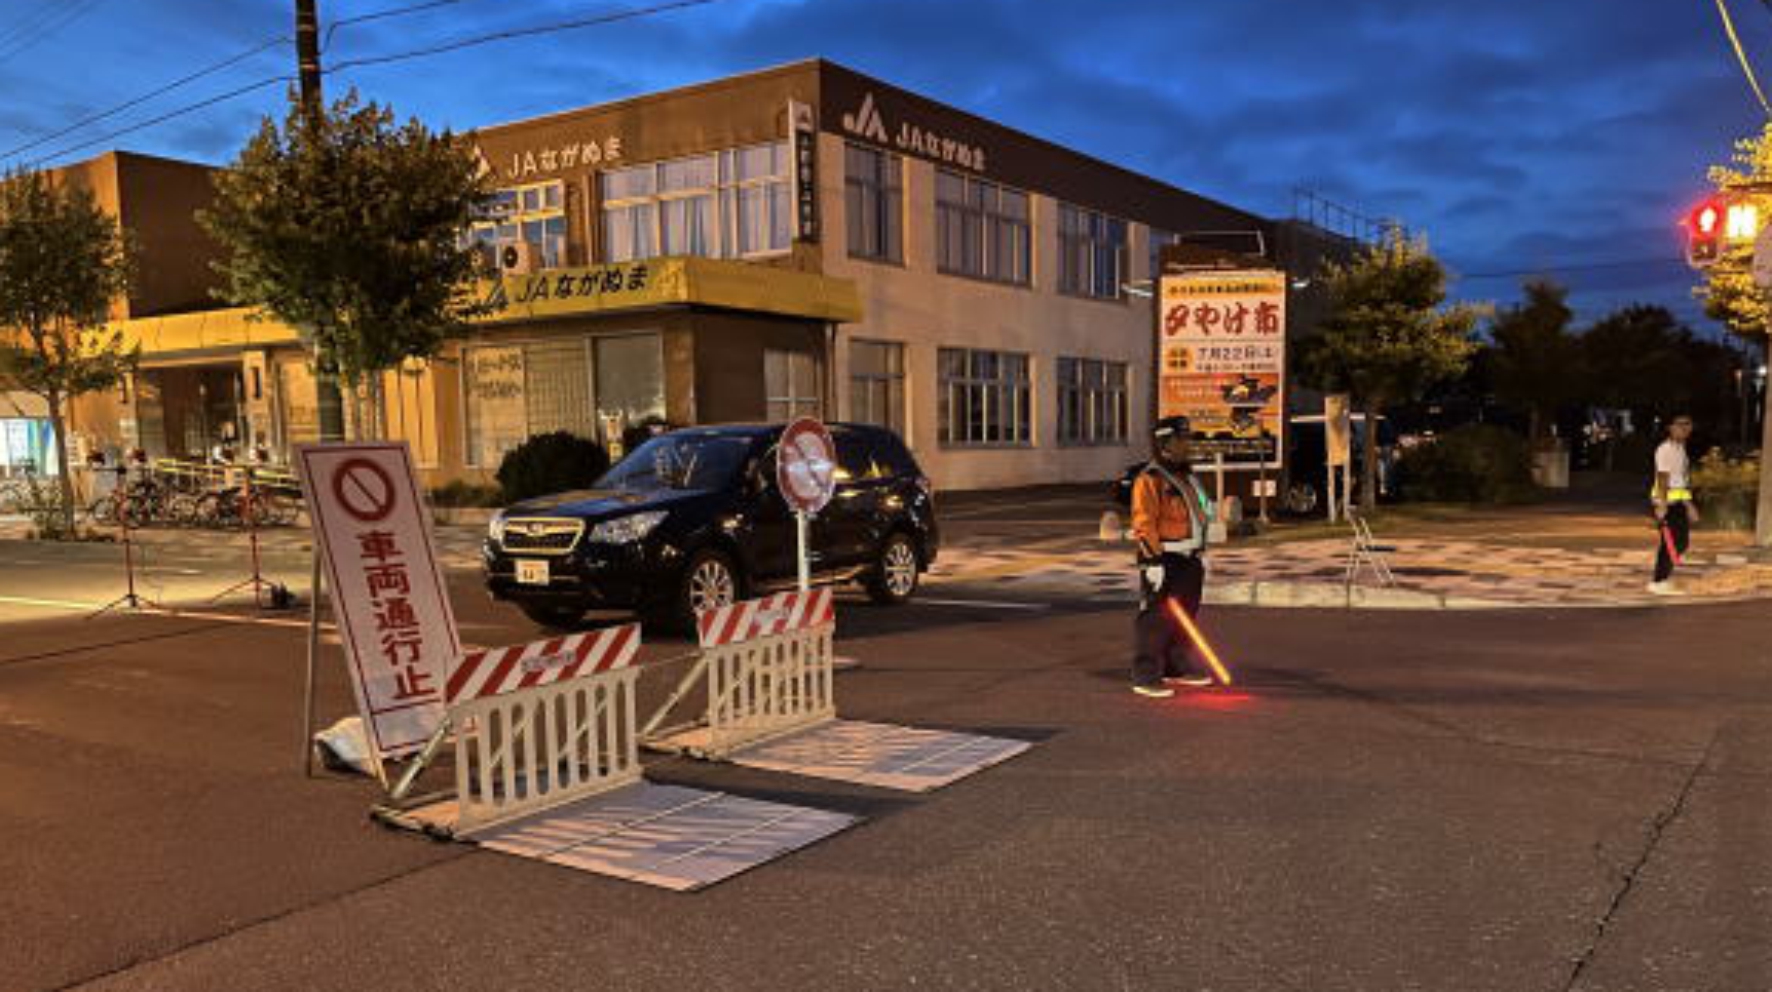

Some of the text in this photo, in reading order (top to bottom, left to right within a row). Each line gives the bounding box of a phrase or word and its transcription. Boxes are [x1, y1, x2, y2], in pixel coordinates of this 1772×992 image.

[508, 134, 622, 178] JAながぬま
[896, 121, 985, 171] JAながぬま
[517, 264, 648, 303] JAながぬま
[1164, 301, 1280, 336] 夕やけ市
[356, 530, 437, 699] 車両通行止
